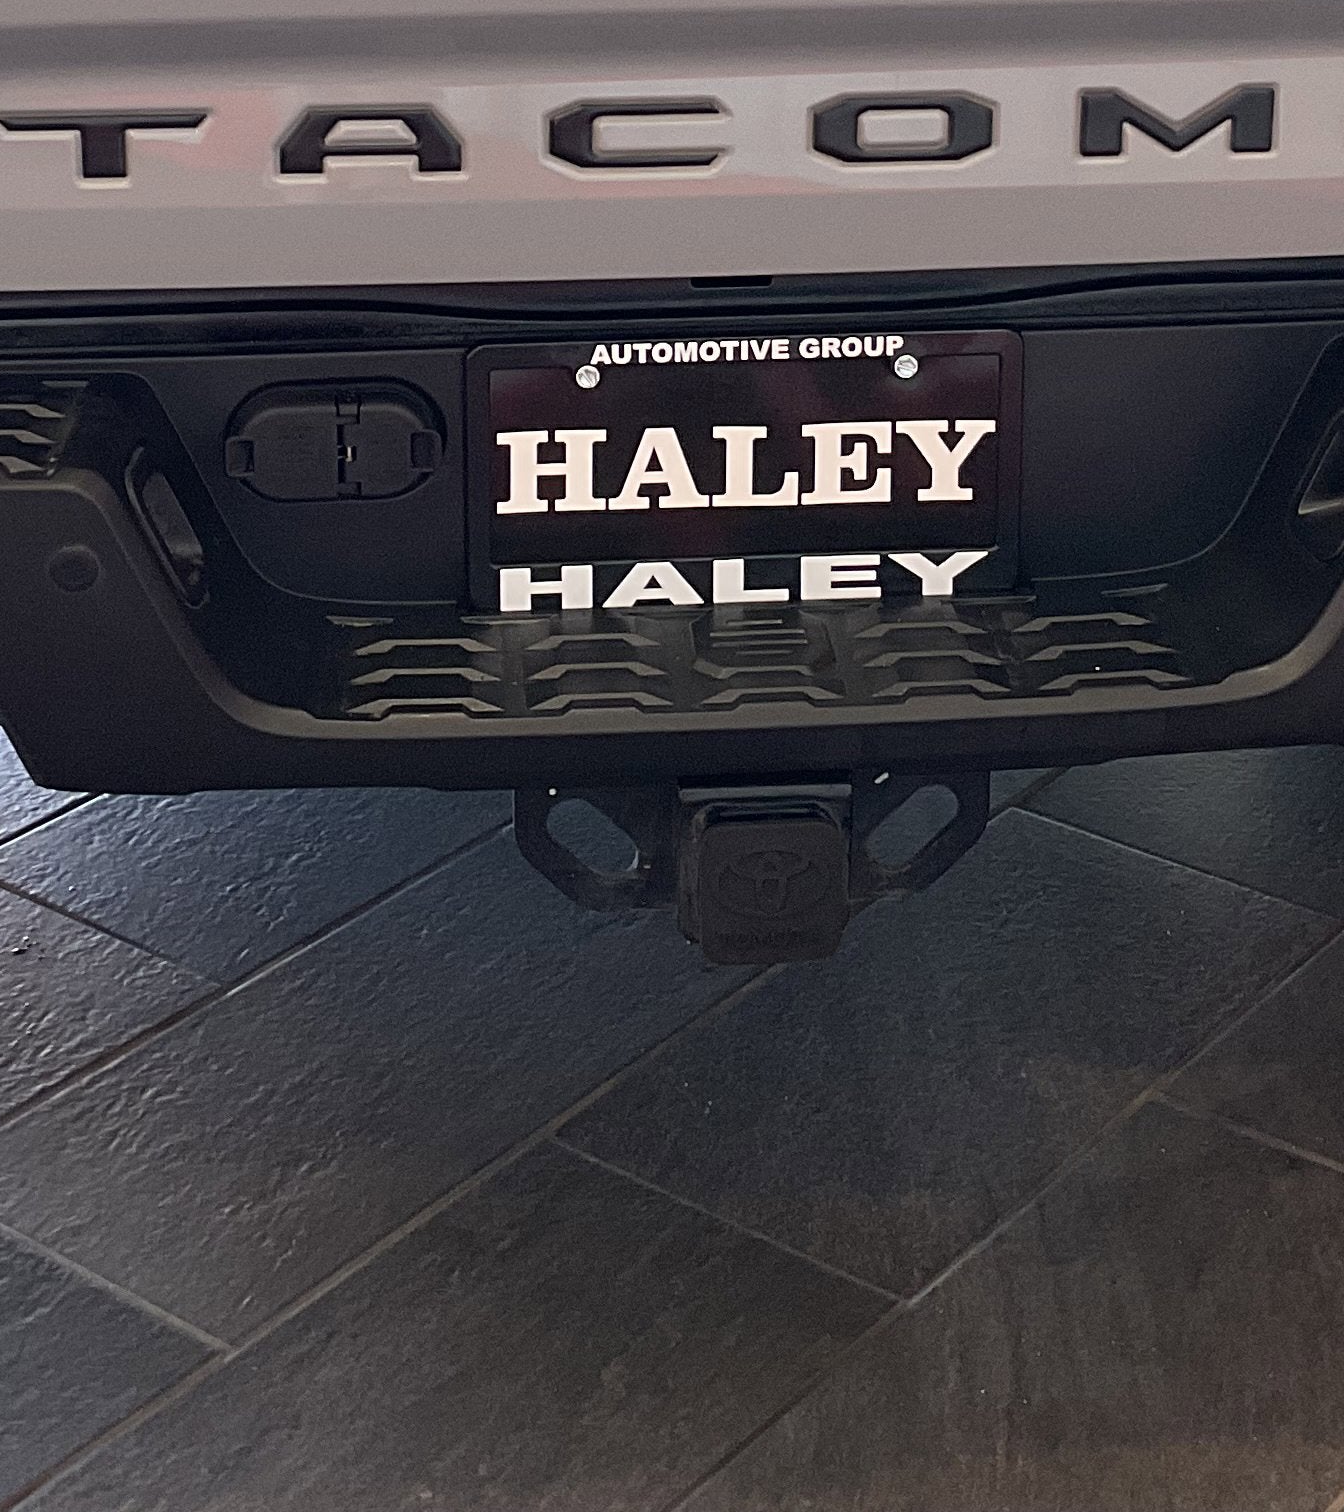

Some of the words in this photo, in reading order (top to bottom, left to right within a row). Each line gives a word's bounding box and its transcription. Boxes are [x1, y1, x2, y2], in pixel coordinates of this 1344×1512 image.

[590, 338, 790, 365] AUTOMOTIVE
[798, 335, 905, 359] GROUP
[496, 418, 997, 514] HALEY
[499, 550, 989, 612] HALEY
